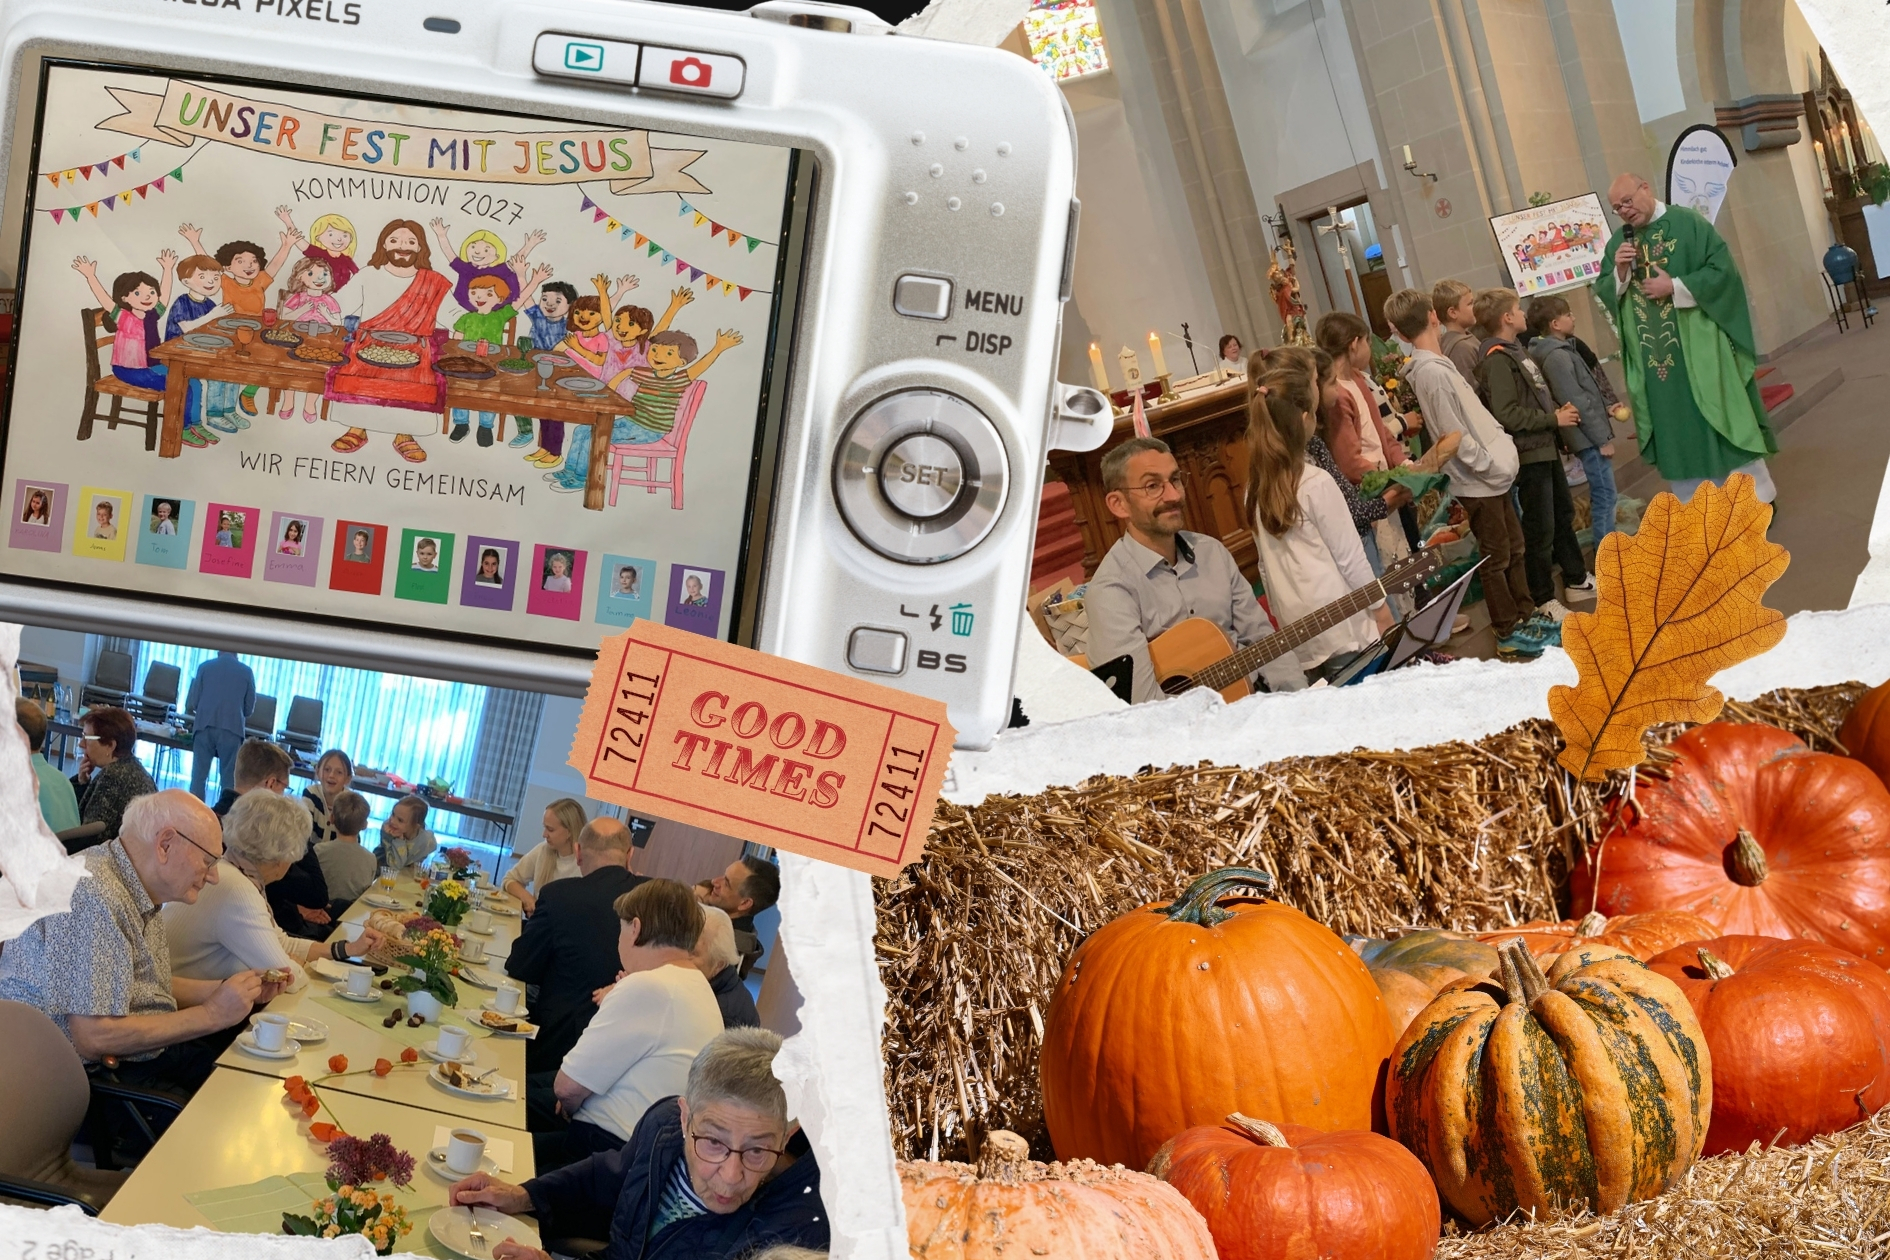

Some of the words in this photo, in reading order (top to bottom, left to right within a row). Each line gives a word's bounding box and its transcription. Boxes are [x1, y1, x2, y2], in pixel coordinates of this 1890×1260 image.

[255, 0, 361, 25] PIXELS
[179, 92, 300, 150] UNSER
[319, 123, 410, 166] FEST
[427, 138, 496, 173] MIT
[513, 138, 632, 176] JESUS
[51, 151, 138, 184] GLAUBE
[292, 178, 449, 206] KOMMUNION
[460, 191, 524, 225] 2027
[681, 205, 756, 248] LIEBE
[965, 289, 1023, 316] MENU
[965, 331, 1012, 355] DISP
[240, 450, 282, 476] WIR
[294, 457, 375, 484] FEIERN
[386, 468, 525, 505] GEMEINSAM
[900, 463, 948, 487] SET
[204, 553, 245, 568] Josefine
[269, 560, 305, 572] Emma
[675, 606, 715, 621] Leonie
[917, 649, 967, 673] BS
